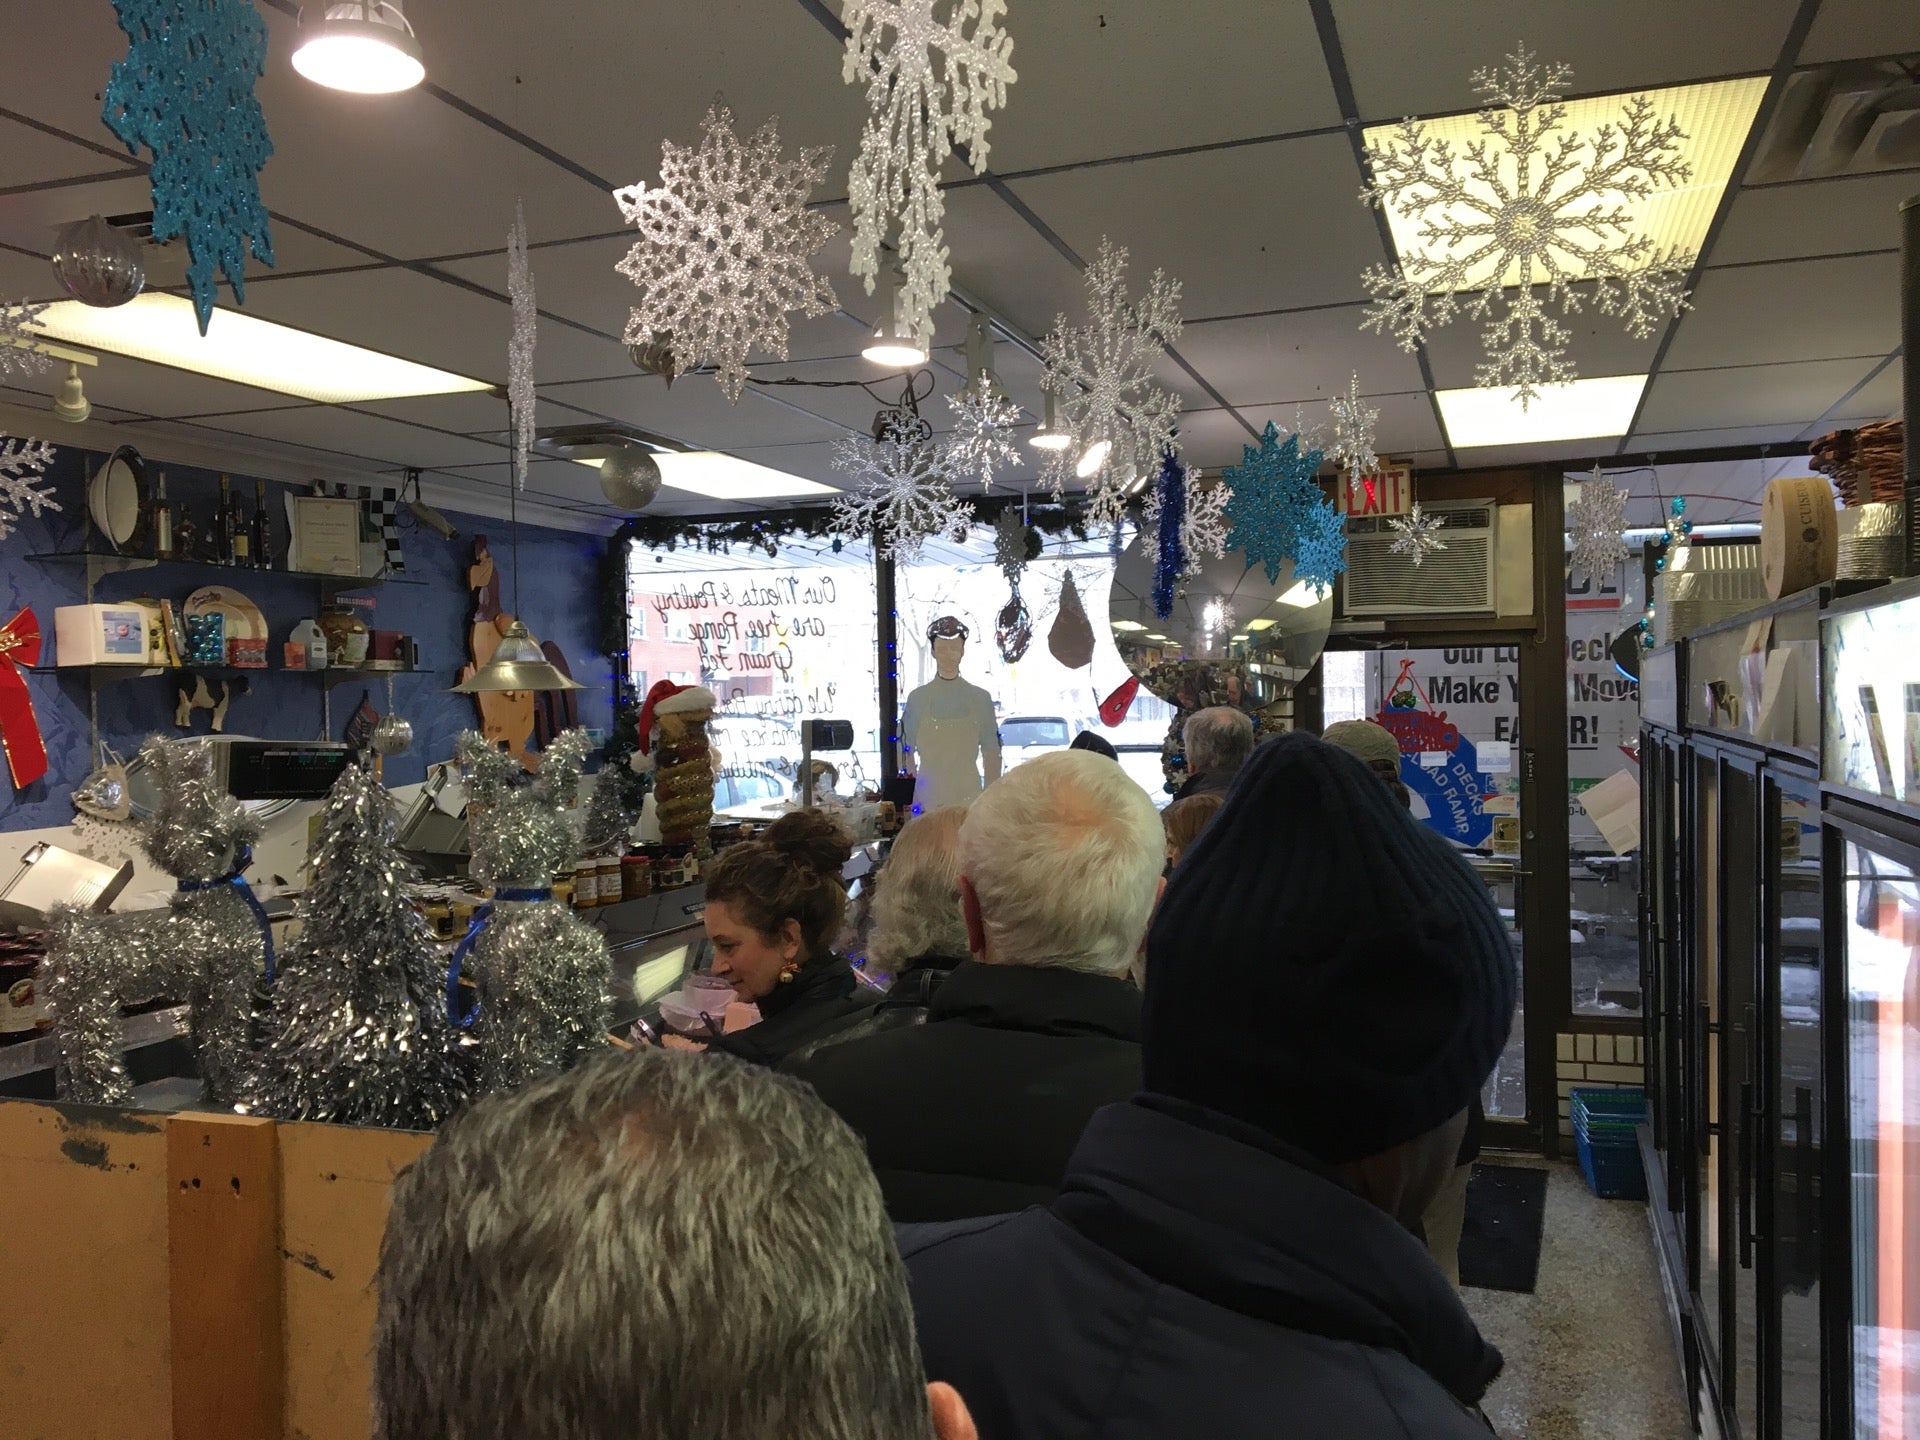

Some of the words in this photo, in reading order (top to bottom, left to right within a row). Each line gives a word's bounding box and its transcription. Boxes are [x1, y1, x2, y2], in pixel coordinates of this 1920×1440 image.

[1346, 471, 1404, 516] EXIT
[1428, 676, 1499, 704] Make
[1443, 787, 1469, 833] RAMP
[1452, 762, 1483, 816] DECKS
